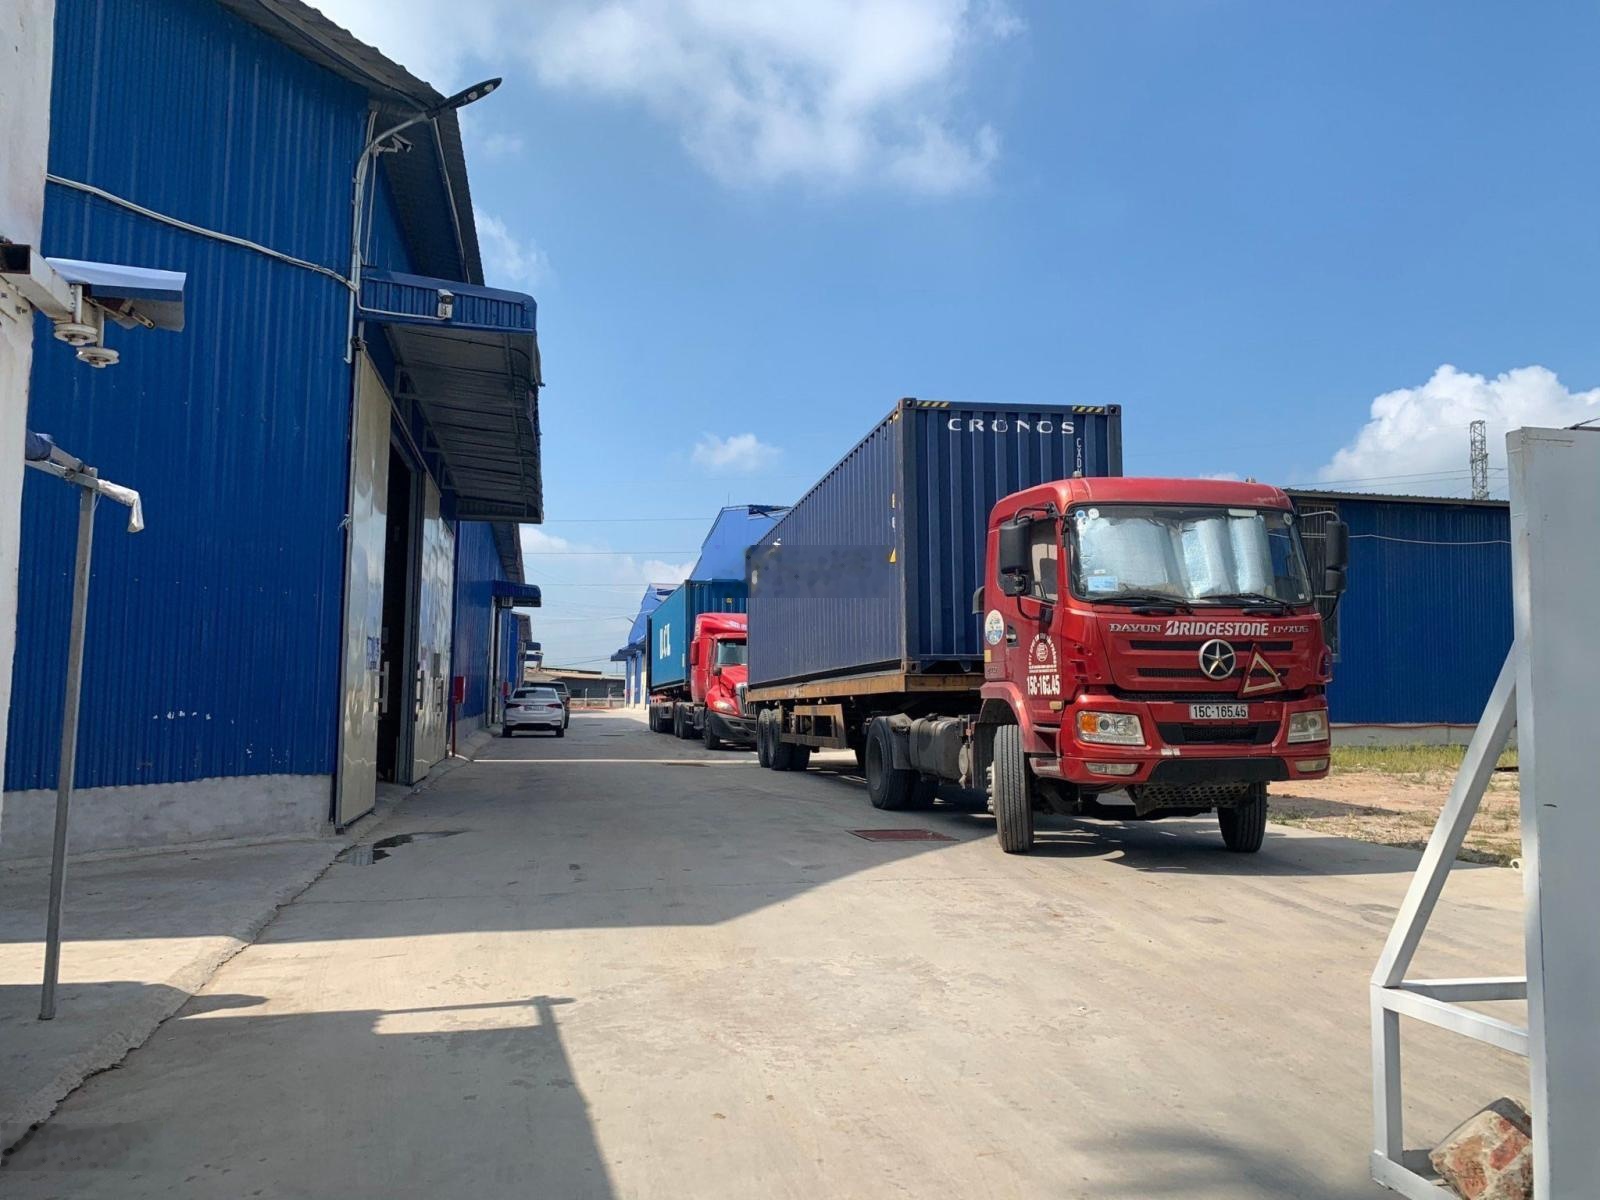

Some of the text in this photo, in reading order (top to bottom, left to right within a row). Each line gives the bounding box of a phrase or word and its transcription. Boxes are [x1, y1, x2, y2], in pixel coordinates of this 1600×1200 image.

[947, 418, 1074, 434] CRONOS
[1109, 623, 1161, 632] DAYUN
[1164, 620, 1270, 636] BRIDGESTONE
[1193, 705, 1247, 718] 15C-165.45
